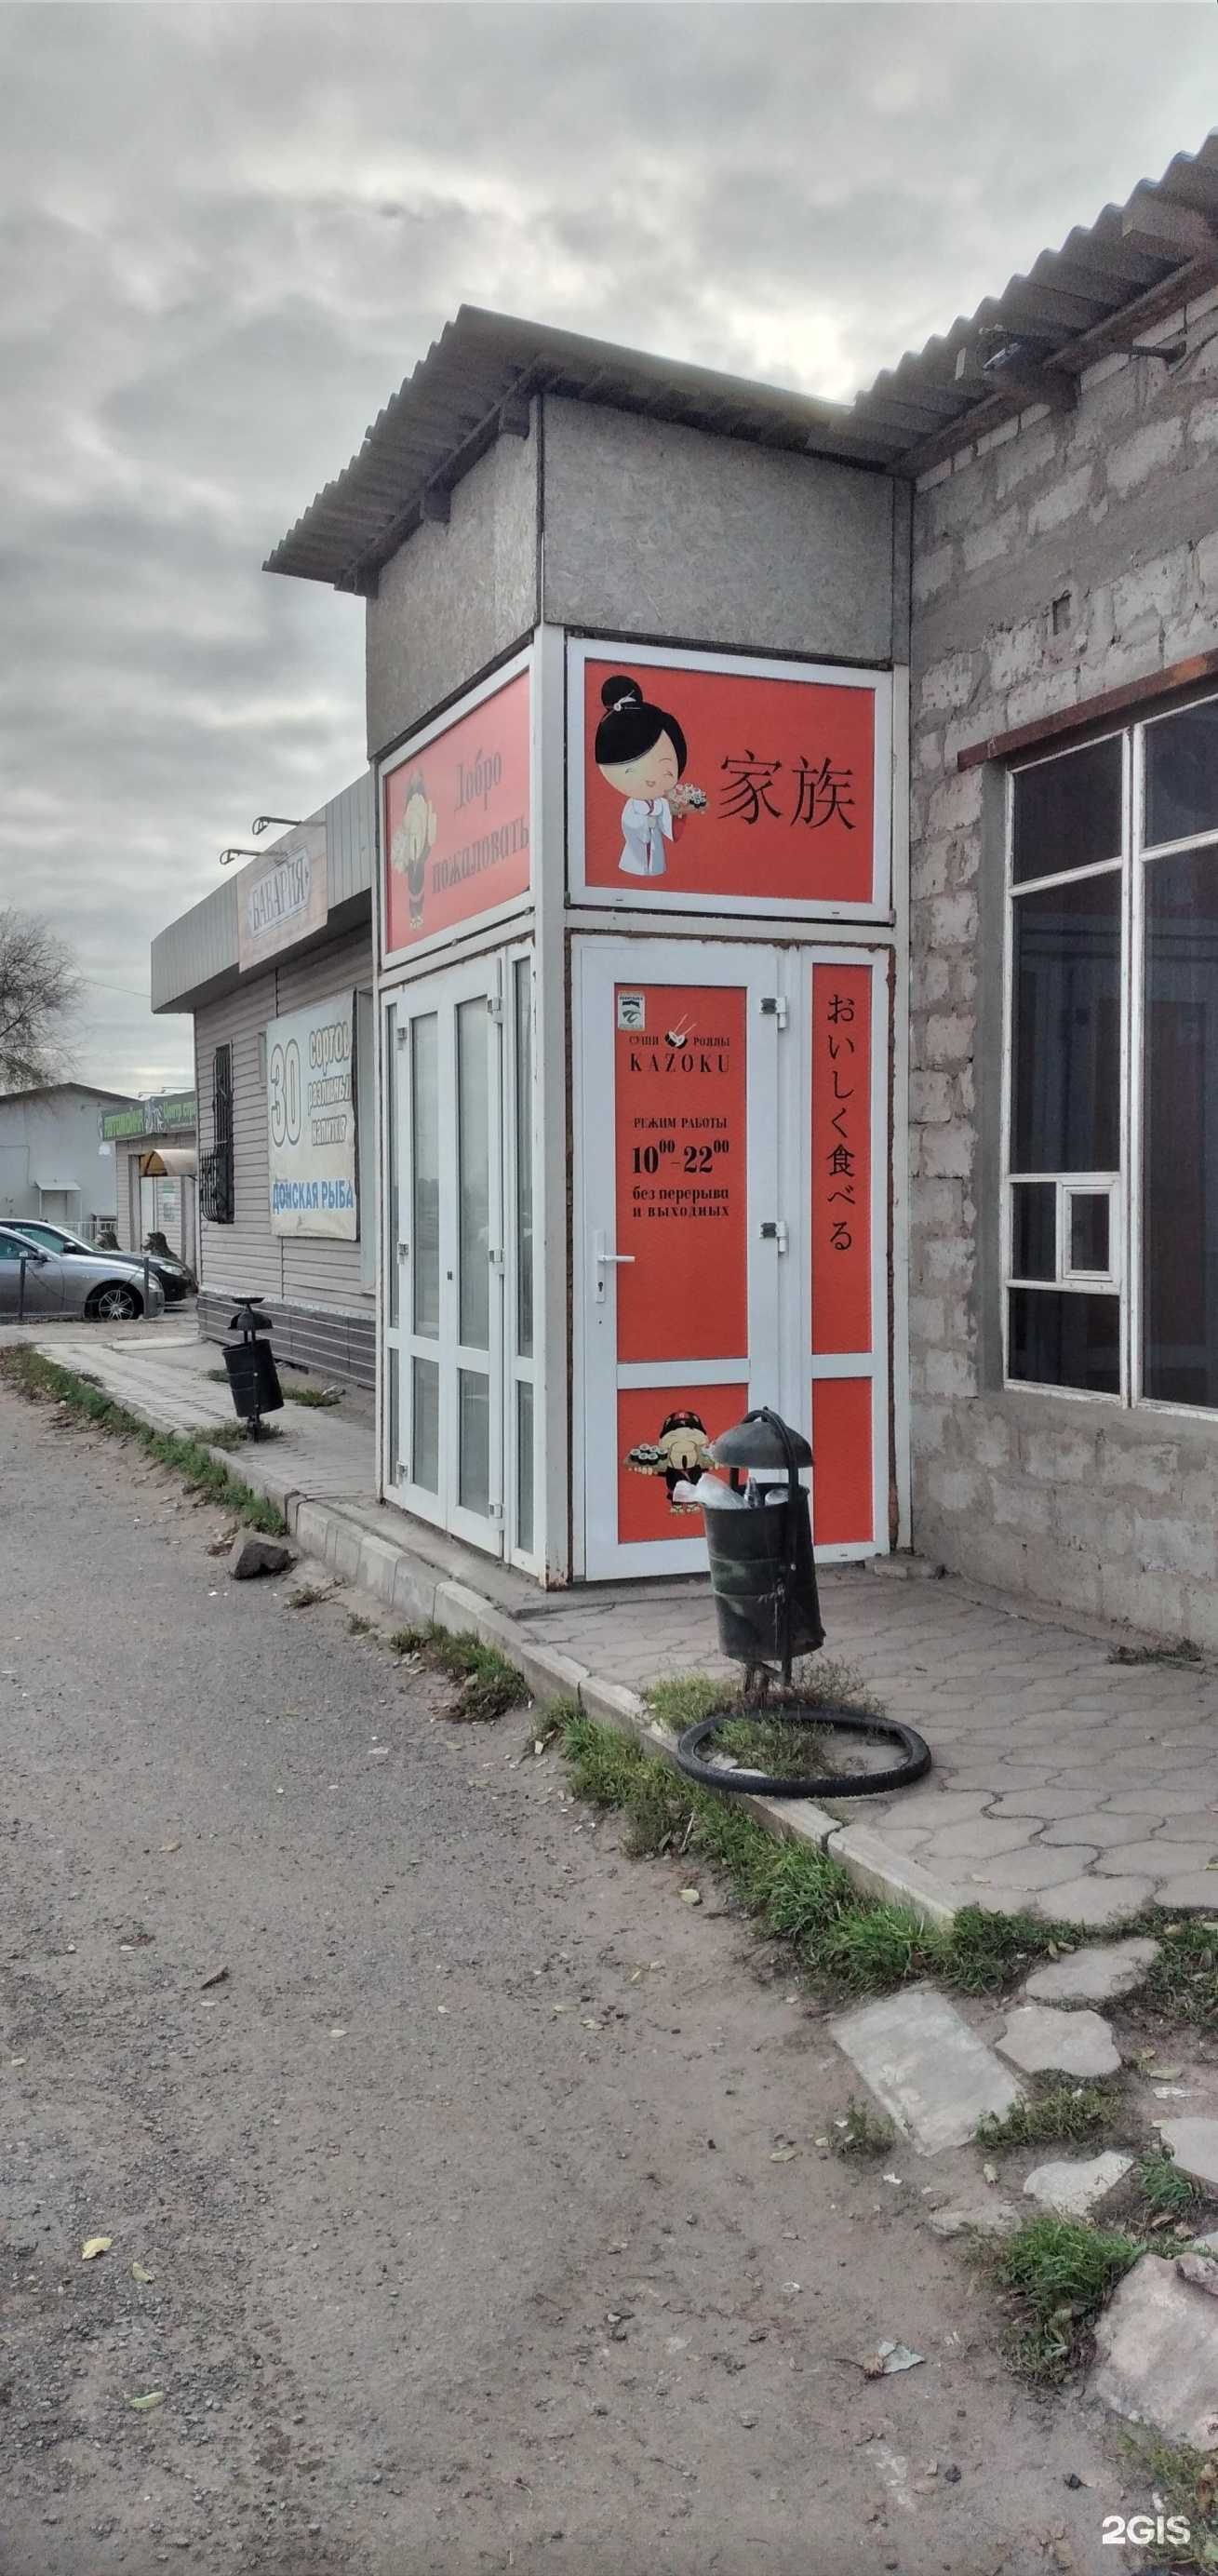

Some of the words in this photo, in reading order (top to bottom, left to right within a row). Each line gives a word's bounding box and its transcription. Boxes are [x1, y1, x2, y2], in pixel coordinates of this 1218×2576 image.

[454, 746, 502, 812] Добро
[717, 749, 857, 830] 家族
[432, 816, 530, 894] пожаловать
[271, 1039, 301, 1147] 30
[629, 1053, 729, 1072] KAZOKU
[634, 1118, 676, 1129] РЕЖИМ
[681, 1118, 728, 1129] РАБОТЫ
[826, 993, 856, 1251] おいしく食べる
[273, 1182, 318, 1214] ДОНСКАЯ
[321, 1180, 354, 1208] РЫБА
[633, 1186, 655, 1200] без
[659, 1188, 729, 1204] перерыва
